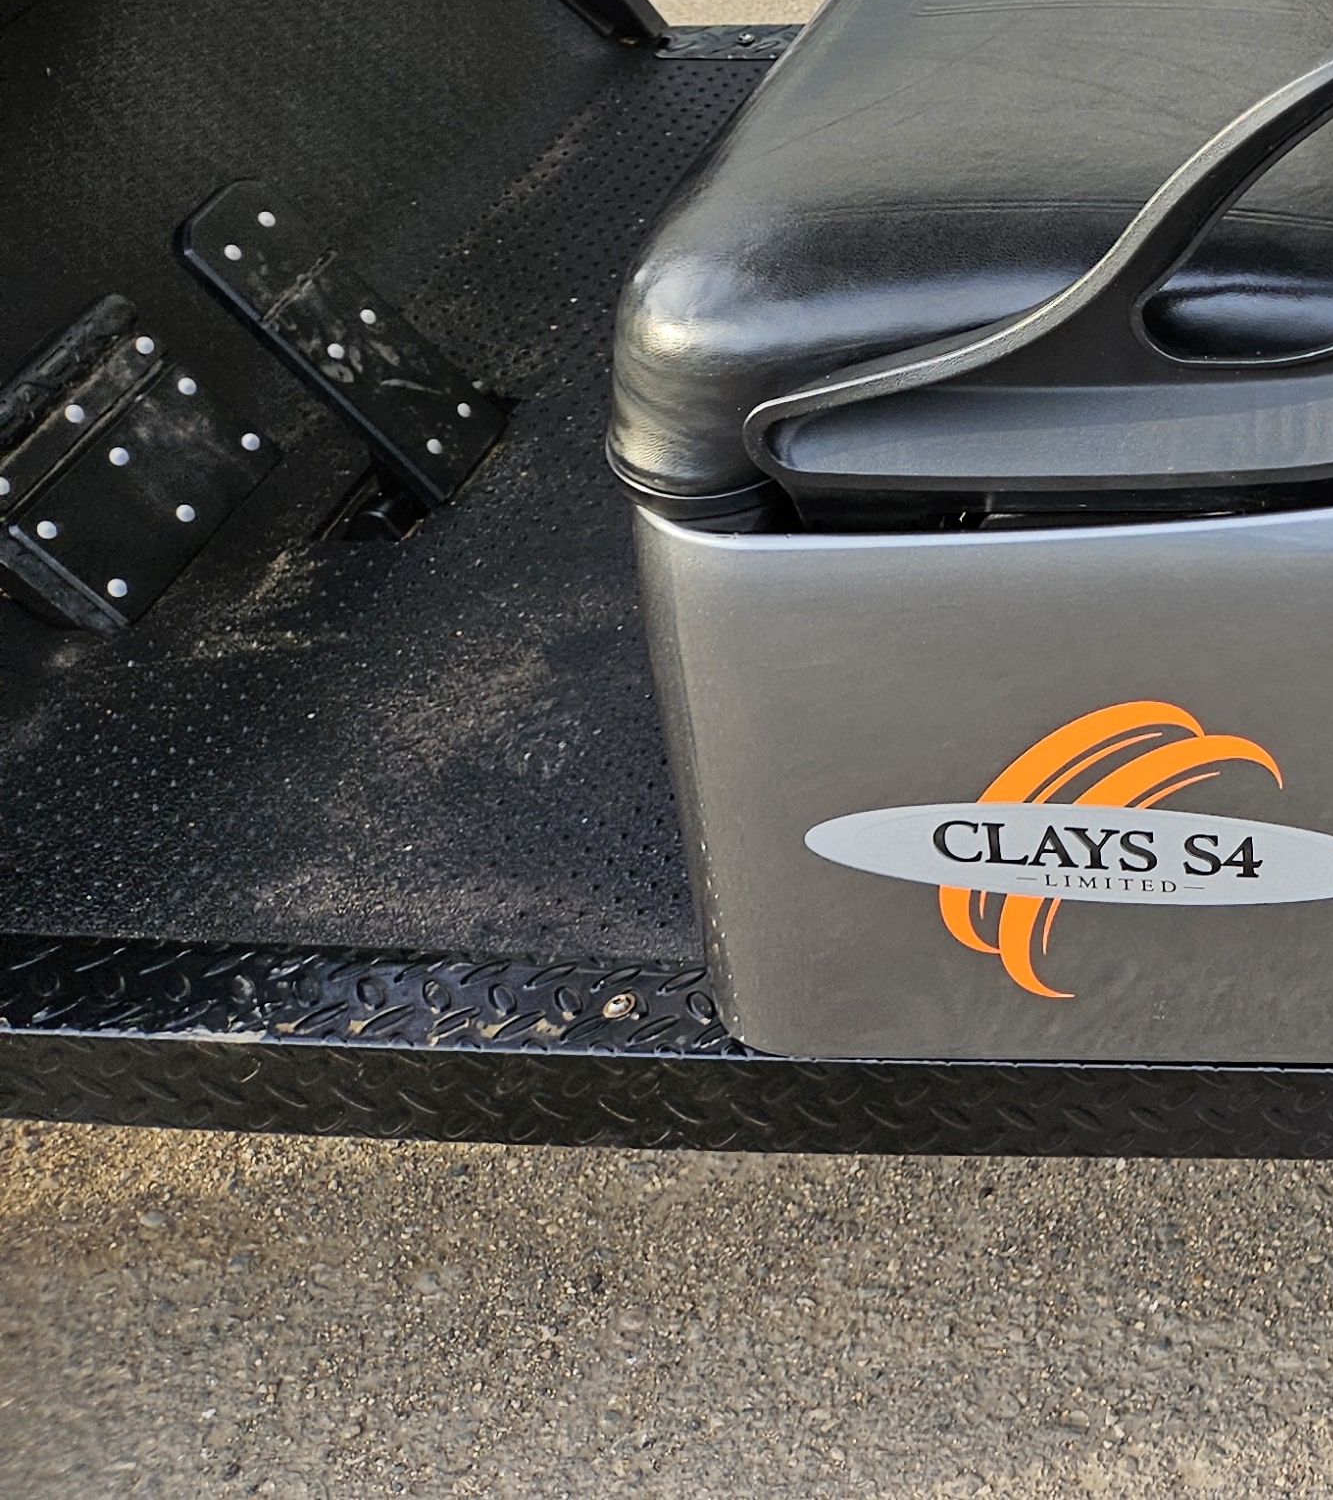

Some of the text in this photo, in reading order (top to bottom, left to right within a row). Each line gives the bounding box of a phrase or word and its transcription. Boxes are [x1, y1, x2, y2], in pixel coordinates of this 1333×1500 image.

[932, 820, 1264, 878] CLAYS S4
[1044, 874, 1177, 894] LIMITED
